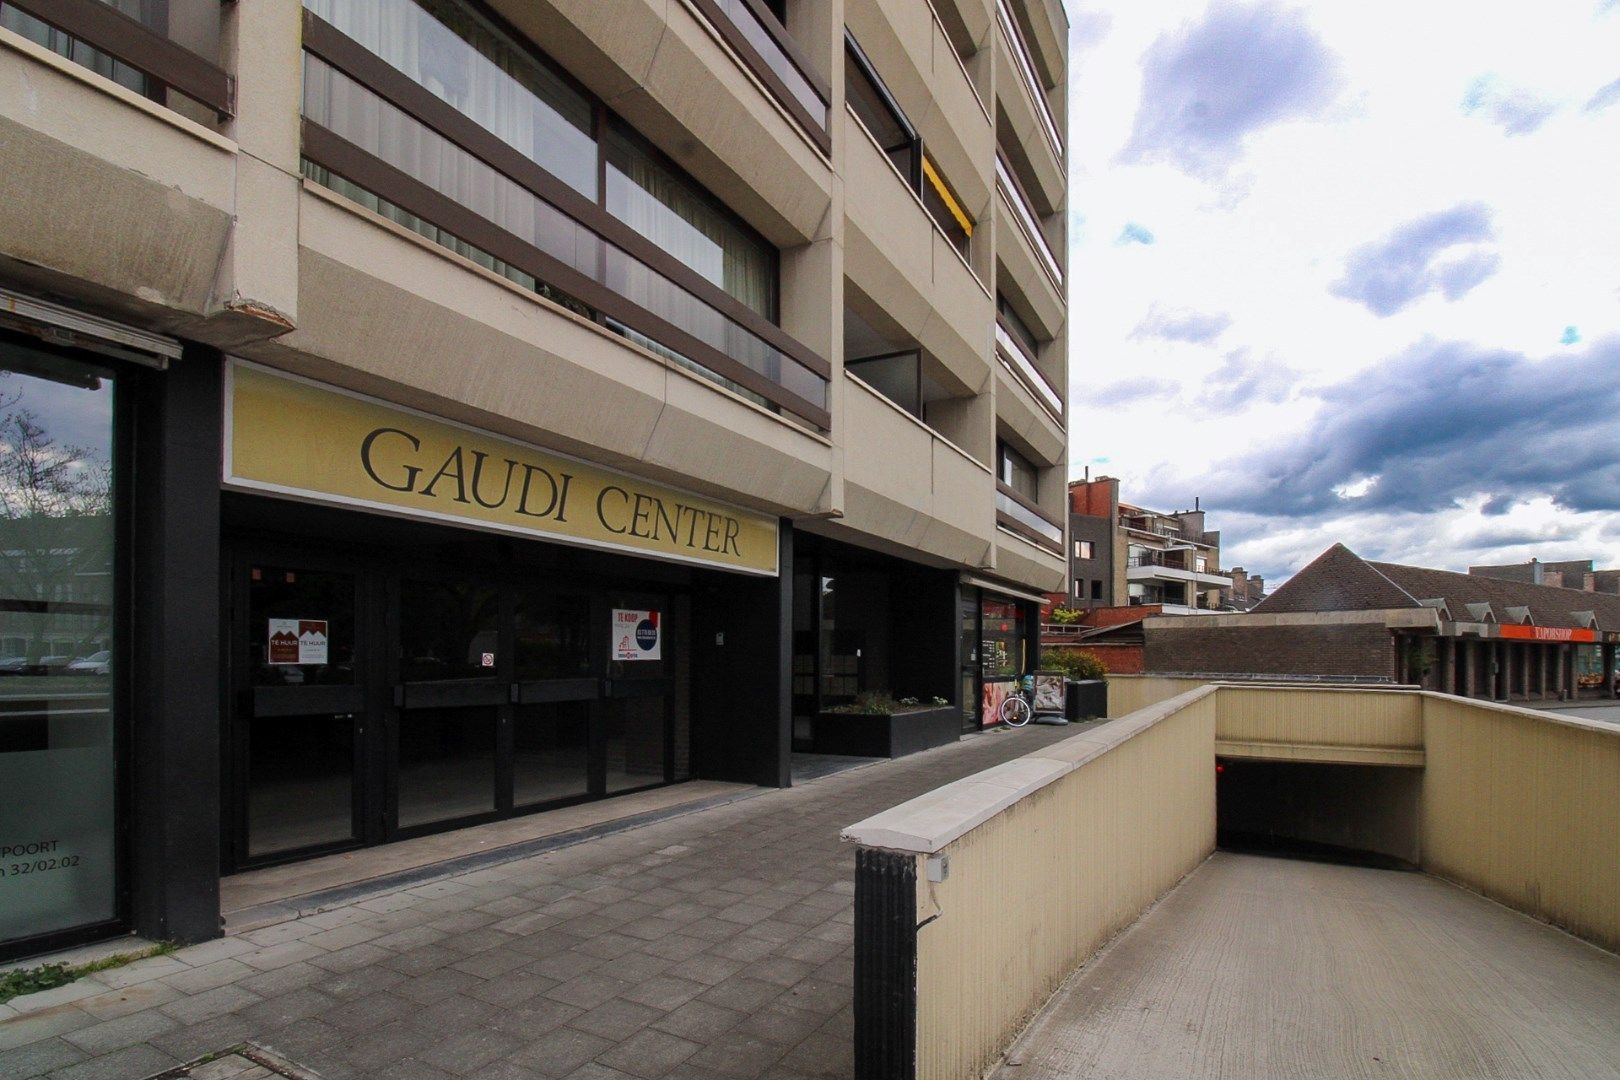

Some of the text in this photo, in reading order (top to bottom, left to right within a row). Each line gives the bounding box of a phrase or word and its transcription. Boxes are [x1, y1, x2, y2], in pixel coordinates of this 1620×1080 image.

[360, 427, 741, 557] GAUDI CENTER
[11, 855, 80, 876] 32/02.02
